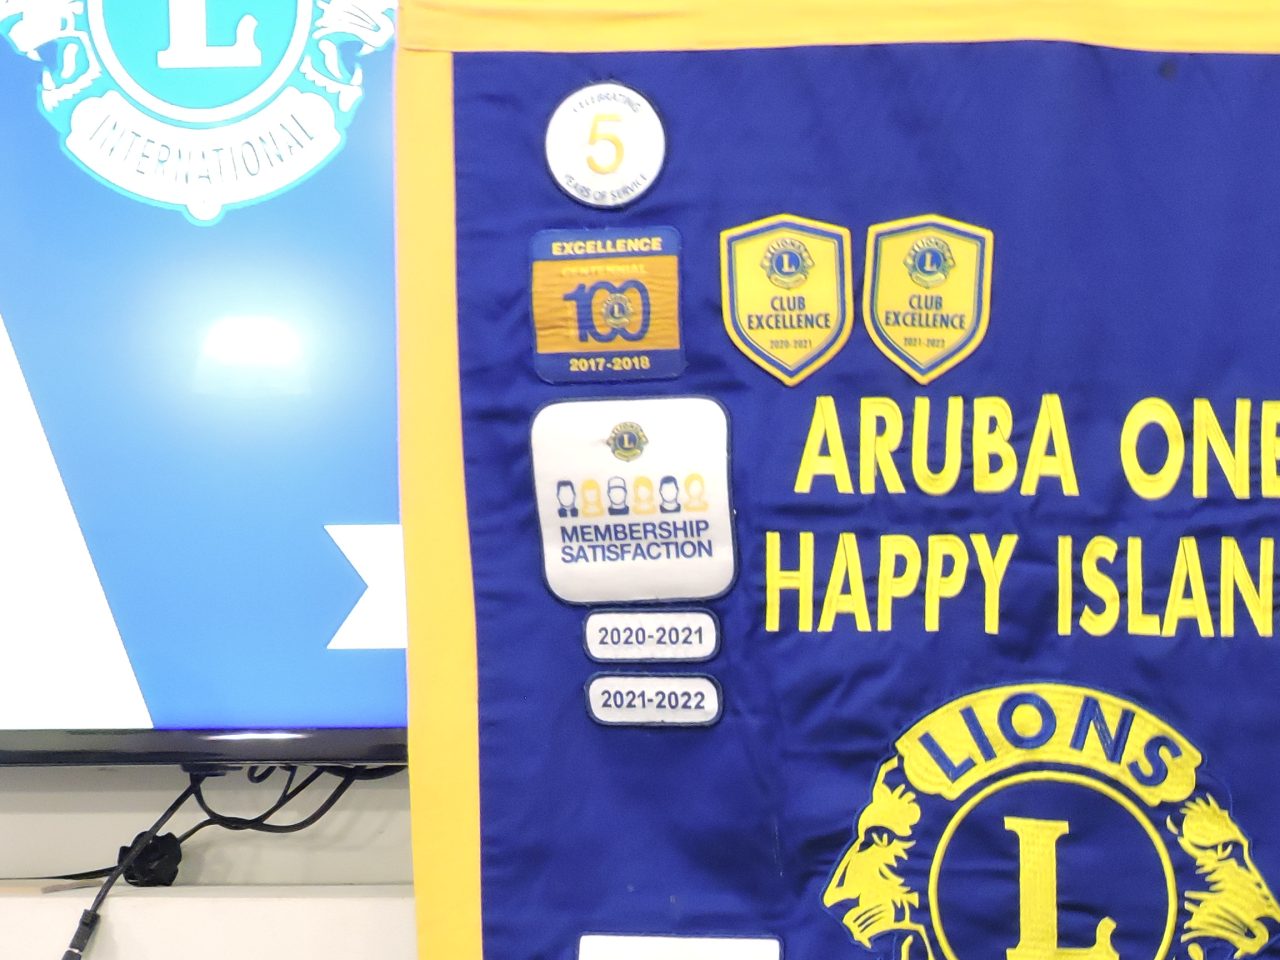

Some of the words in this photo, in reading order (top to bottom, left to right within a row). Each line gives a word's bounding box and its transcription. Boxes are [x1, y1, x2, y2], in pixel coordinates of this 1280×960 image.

[89, 114, 315, 184] INTERNATIONAL
[585, 112, 625, 176] 5
[552, 237, 662, 256] EXCELLENCE
[782, 252, 796, 273] L
[924, 252, 938, 273] L
[563, 279, 651, 343] 100
[770, 296, 806, 312] CLUB
[908, 294, 943, 310] CLUB
[747, 313, 831, 330] EXCELLENCE
[884, 310, 966, 330] EXCELLENCE
[769, 339, 813, 350] 2020-2021
[569, 357, 651, 372] 2017-2018
[793, 393, 1079, 498] ARUBA
[560, 519, 709, 543] MEMBERSHIP
[561, 540, 713, 564] SATISFACTION
[765, 530, 1019, 636] HAPPY
[598, 626, 704, 646] 2020-2021
[600, 689, 706, 710] 2021-2022
[918, 691, 1182, 787] LIONS
